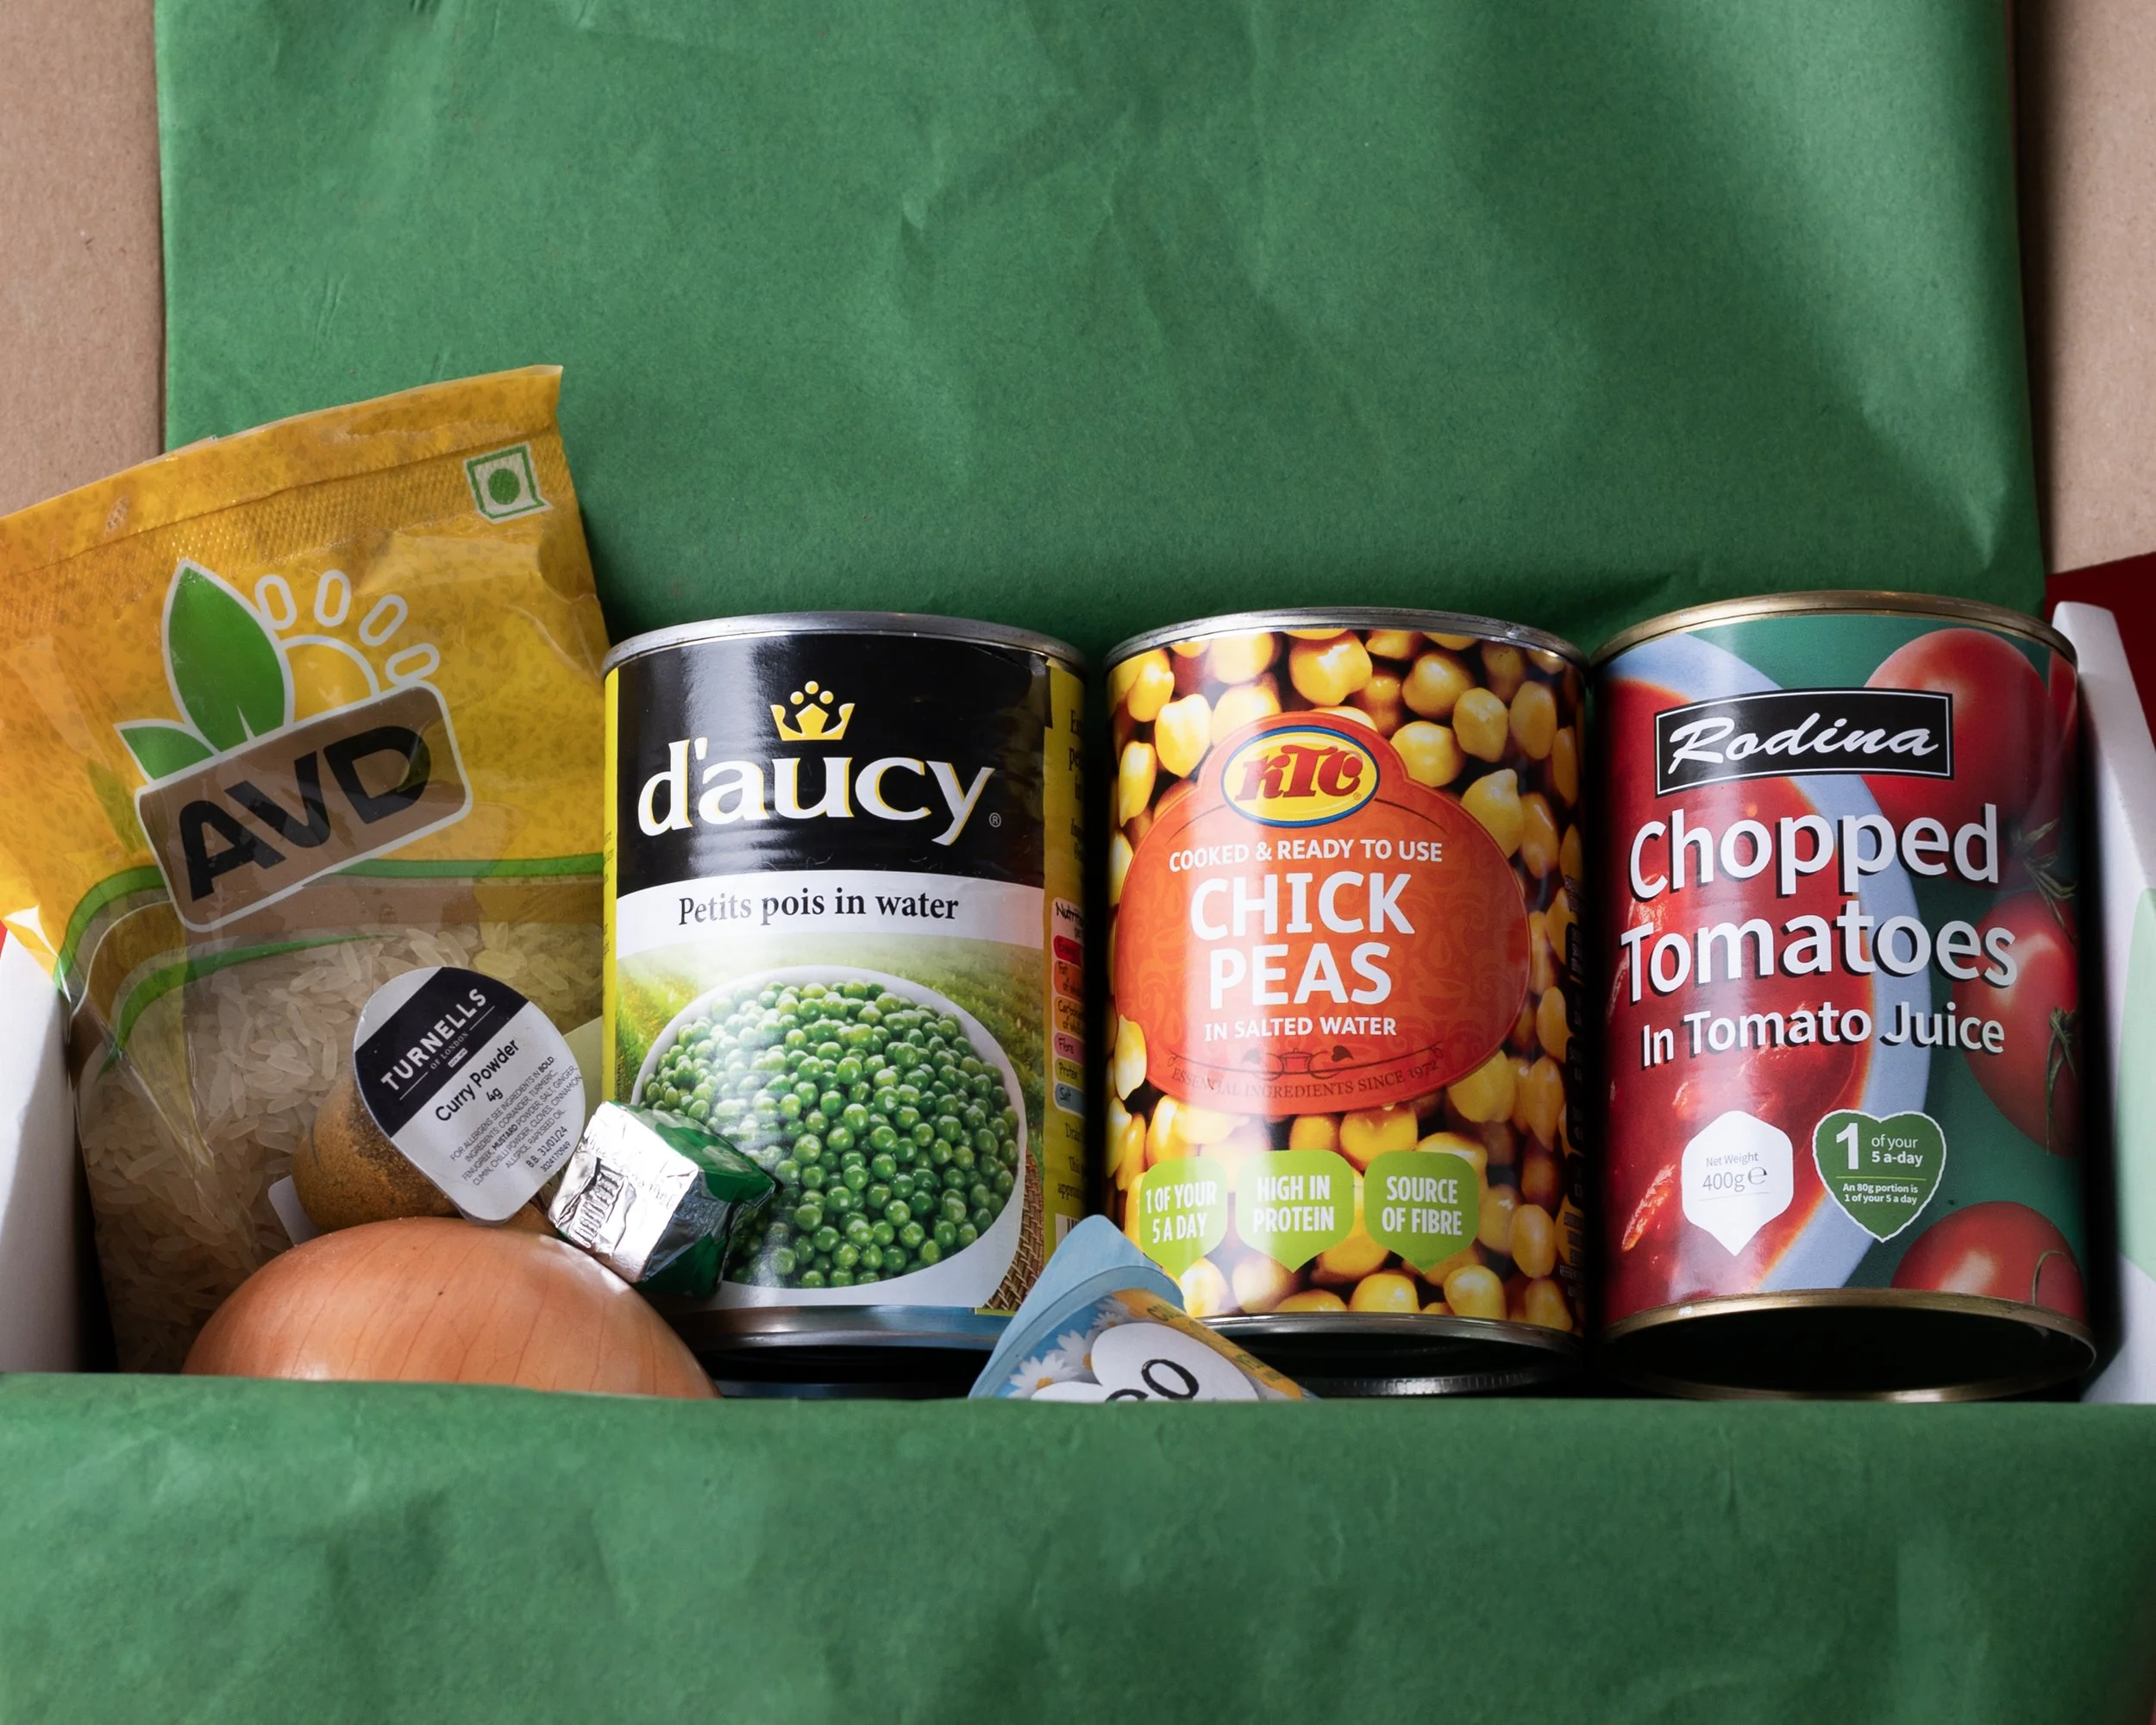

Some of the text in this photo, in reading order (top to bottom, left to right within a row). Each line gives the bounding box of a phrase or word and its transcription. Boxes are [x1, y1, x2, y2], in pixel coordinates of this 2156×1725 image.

[1668, 712, 1940, 775] Rodina
[1235, 744, 1363, 802] KTC
[638, 737, 996, 846] d'aucy
[178, 725, 431, 902] AVD
[1169, 839, 1443, 873] COOKED & READY TO USE
[1630, 803, 1999, 900] Chopped
[679, 887, 959, 925] Petits pois in water
[1190, 871, 1415, 942] CHICK
[1621, 900, 2018, 1002] Tomatoes
[1210, 942, 1392, 1009] PEAS
[381, 988, 486, 1090] TURNELLS
[1204, 1016, 1398, 1042] IN SALTED WATER
[1642, 1001, 2006, 1068] In Tomato Juice
[430, 1059, 440, 1070] OF
[440, 1033, 468, 1059] LONDON
[436, 1083, 476, 1121] Curry
[469, 1039, 519, 1088] Powder
[486, 1088, 504, 1102] 4g
[1245, 1082, 1354, 1100] INGREDIENTS
[1357, 1070, 1405, 1092] SINCE
[1409, 1062, 1439, 1080] 1972
[449, 1146, 466, 1161] FOR
[463, 1117, 493, 1149] ALLERGENS
[491, 1107, 504, 1120] SEE
[500, 1076, 535, 1111] INGREDIENTS
[527, 1118, 555, 1145] RAPESEED
[492, 1124, 518, 1151] MUSTARD
[537, 1126, 567, 1157] 31/01/24
[1836, 1122, 1859, 1170] 1
[1871, 1135, 1918, 1151] of your
[490, 1149, 510, 1168] CHILLI
[1706, 1151, 1758, 1168] Net Weight
[1871, 1151, 1923, 1167] 5 a-day
[1145, 1181, 1218, 1214] 1 OF YOUR
[1257, 1175, 1331, 1201] HIGH IN
[1386, 1176, 1458, 1205] SOURCE
[1702, 1170, 1745, 1193] 400g
[1842, 1182, 1918, 1195] An 80g portion is
[1852, 1192, 1862, 1202] of
[1863, 1195, 1884, 1205] your
[1886, 1194, 1891, 1202] 5
[1900, 1193, 1918, 1206] day
[1152, 1214, 1208, 1244] 5 A DAY
[1252, 1206, 1335, 1234] PROTEIN
[1382, 1207, 1463, 1237] OF FIBRE
